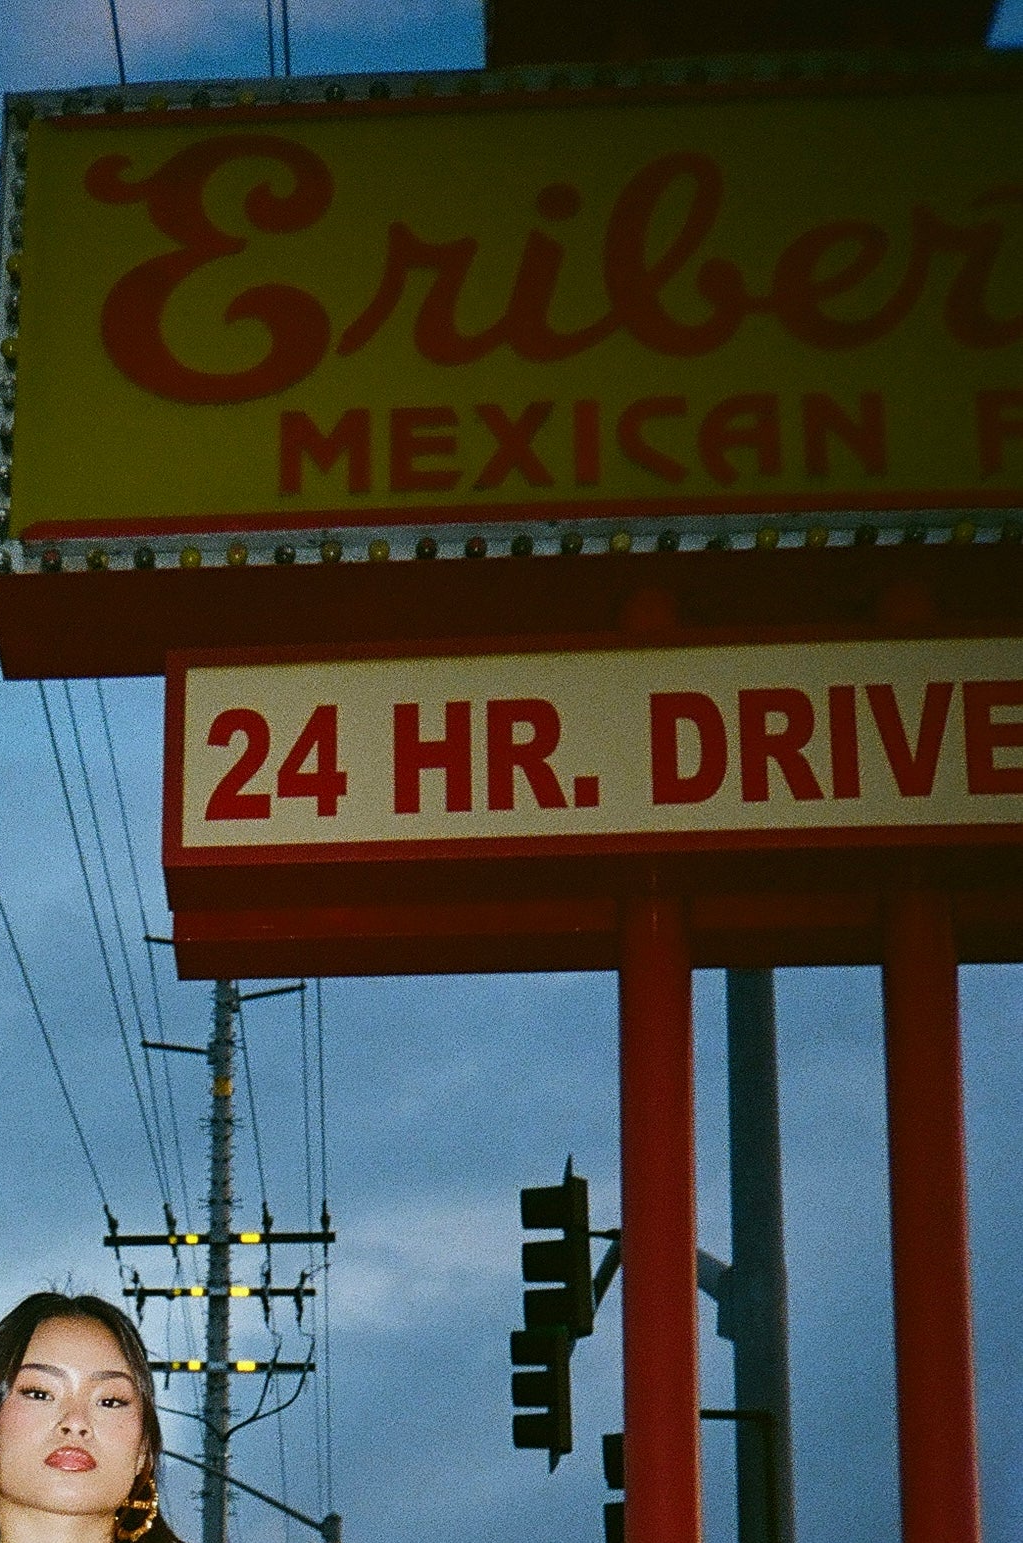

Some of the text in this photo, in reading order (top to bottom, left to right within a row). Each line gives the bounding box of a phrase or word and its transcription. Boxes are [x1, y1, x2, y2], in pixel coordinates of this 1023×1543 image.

[83, 132, 1023, 405] Eriber
[278, 390, 888, 496] MEXICAN
[204, 680, 1023, 821] 24 HR. DRIVE
